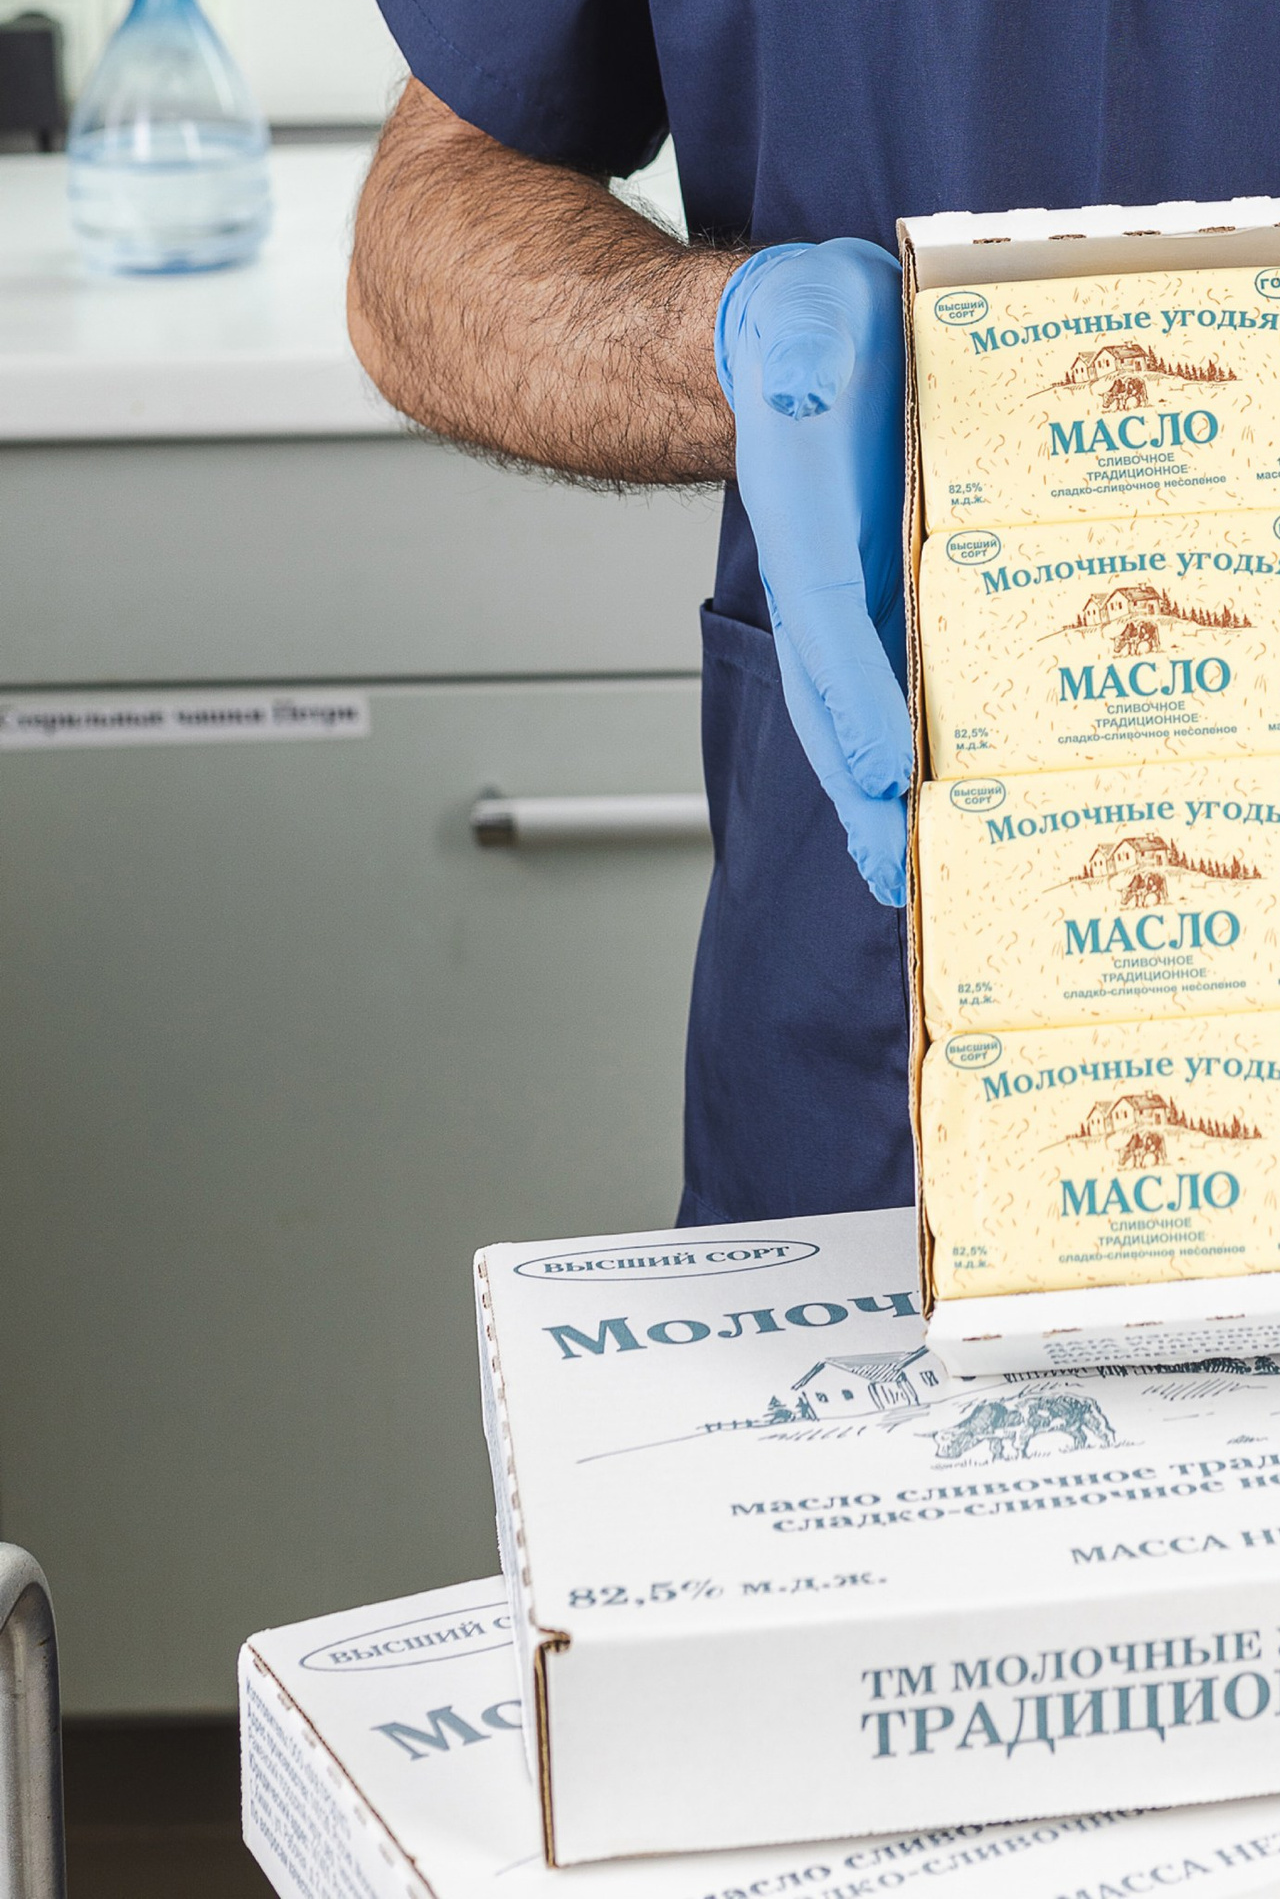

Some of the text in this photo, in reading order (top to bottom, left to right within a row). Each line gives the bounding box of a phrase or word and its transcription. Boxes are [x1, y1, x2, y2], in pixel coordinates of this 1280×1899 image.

[937, 299, 985, 313] ВЫСШИЙ
[947, 308, 975, 320] СОРТ
[969, 309, 1280, 354] Молочные угодья
[1049, 410, 1218, 455] МАСЛО
[1097, 452, 1175, 468] СЛИВОЧНОЕ
[1085, 464, 1189, 483] ТРАДИЦИОННОЕ
[947, 482, 983, 495] 82,5%
[1049, 474, 1227, 499] сладко-сливочное несоленое
[949, 538, 998, 551] ВЫСШИЙ
[959, 547, 987, 559] СОРТ
[980, 552, 1166, 593] Молочные
[1058, 657, 1230, 701] МАСЛО
[1106, 700, 1186, 716] СЛИВОЧНОЕ
[953, 726, 990, 739] 82,5%
[1093, 712, 1199, 730] ТРАДИЦИОННОЕ
[1057, 724, 1238, 745] сладко-сливочное несоленое
[952, 784, 1003, 798] ВЫСШИЙ
[963, 794, 992, 806] СОРТ
[985, 801, 1175, 843] Молочные
[1064, 910, 1240, 955] МАСЛО
[1113, 954, 1194, 970] СЛИВОЧНОЕ
[956, 980, 994, 994] 82,5%
[1100, 967, 1208, 985] ТРАДИЦИОННОЕ
[1062, 979, 1248, 1001] сладко-сливочное несоленое
[980, 1056, 1174, 1100] Молочные
[1061, 1171, 1239, 1217] МАСЛО
[543, 1245, 790, 1274] ВЫСШИЙ СОРТ
[541, 1290, 921, 1360] Молоч
[730, 1491, 882, 1518] масло
[895, 1465, 1157, 1503] сливочное
[771, 1478, 1225, 1533] сладко-сливочное
[1069, 1532, 1230, 1565] МАССА
[567, 1570, 889, 1610] 82,5% м.д.ж.
[327, 1620, 488, 1666] ВЫСШИЙ
[859, 1662, 937, 1701] ТМ
[950, 1629, 1264, 1693] МОЛОЧНЫЕ
